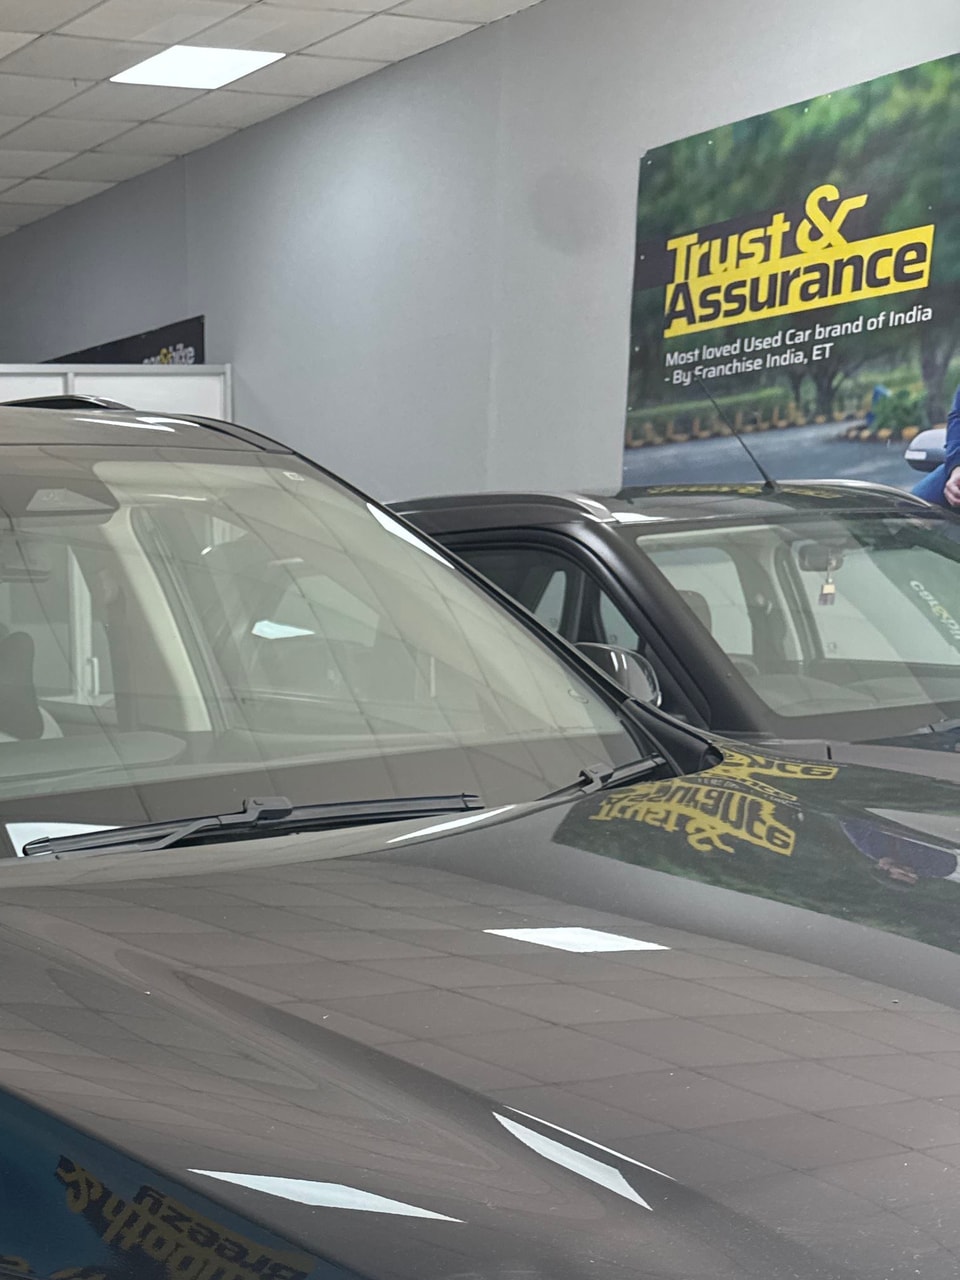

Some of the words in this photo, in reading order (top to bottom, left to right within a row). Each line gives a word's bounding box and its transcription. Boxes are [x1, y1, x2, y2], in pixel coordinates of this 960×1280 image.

[667, 213, 790, 284] Trust
[796, 184, 868, 253] &
[664, 241, 928, 329] Assurance
[665, 348, 699, 367] Most
[702, 338, 740, 360] loved
[744, 331, 782, 353] Used
[785, 328, 813, 345] Car
[814, 315, 863, 340] brand
[866, 311, 887, 331] of
[889, 304, 933, 327] India
[672, 369, 692, 386] By
[694, 357, 763, 380] Franchise
[766, 348, 809, 368] India,
[812, 342, 835, 361] ET
